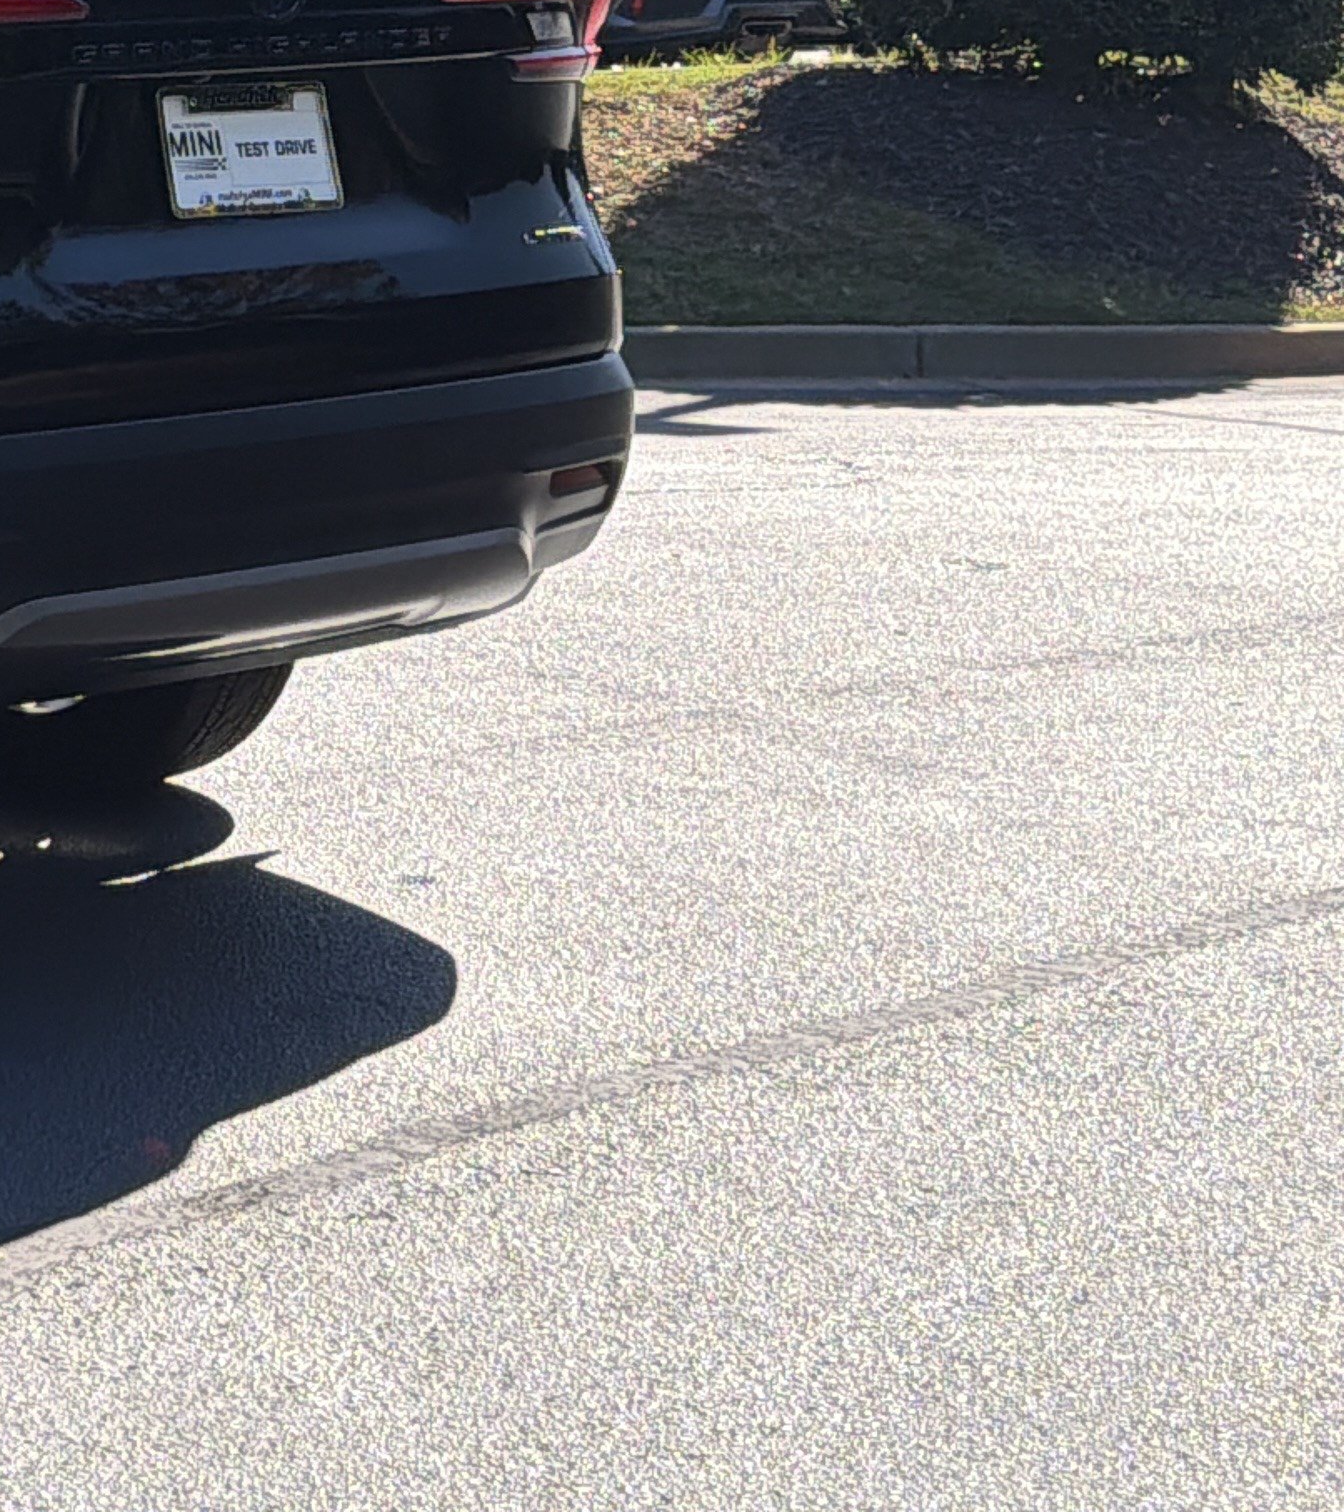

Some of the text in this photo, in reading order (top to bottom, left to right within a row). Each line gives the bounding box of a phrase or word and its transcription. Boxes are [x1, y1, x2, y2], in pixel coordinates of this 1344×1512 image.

[169, 130, 223, 157] MINI
[235, 138, 317, 158] TEST DRIVE
